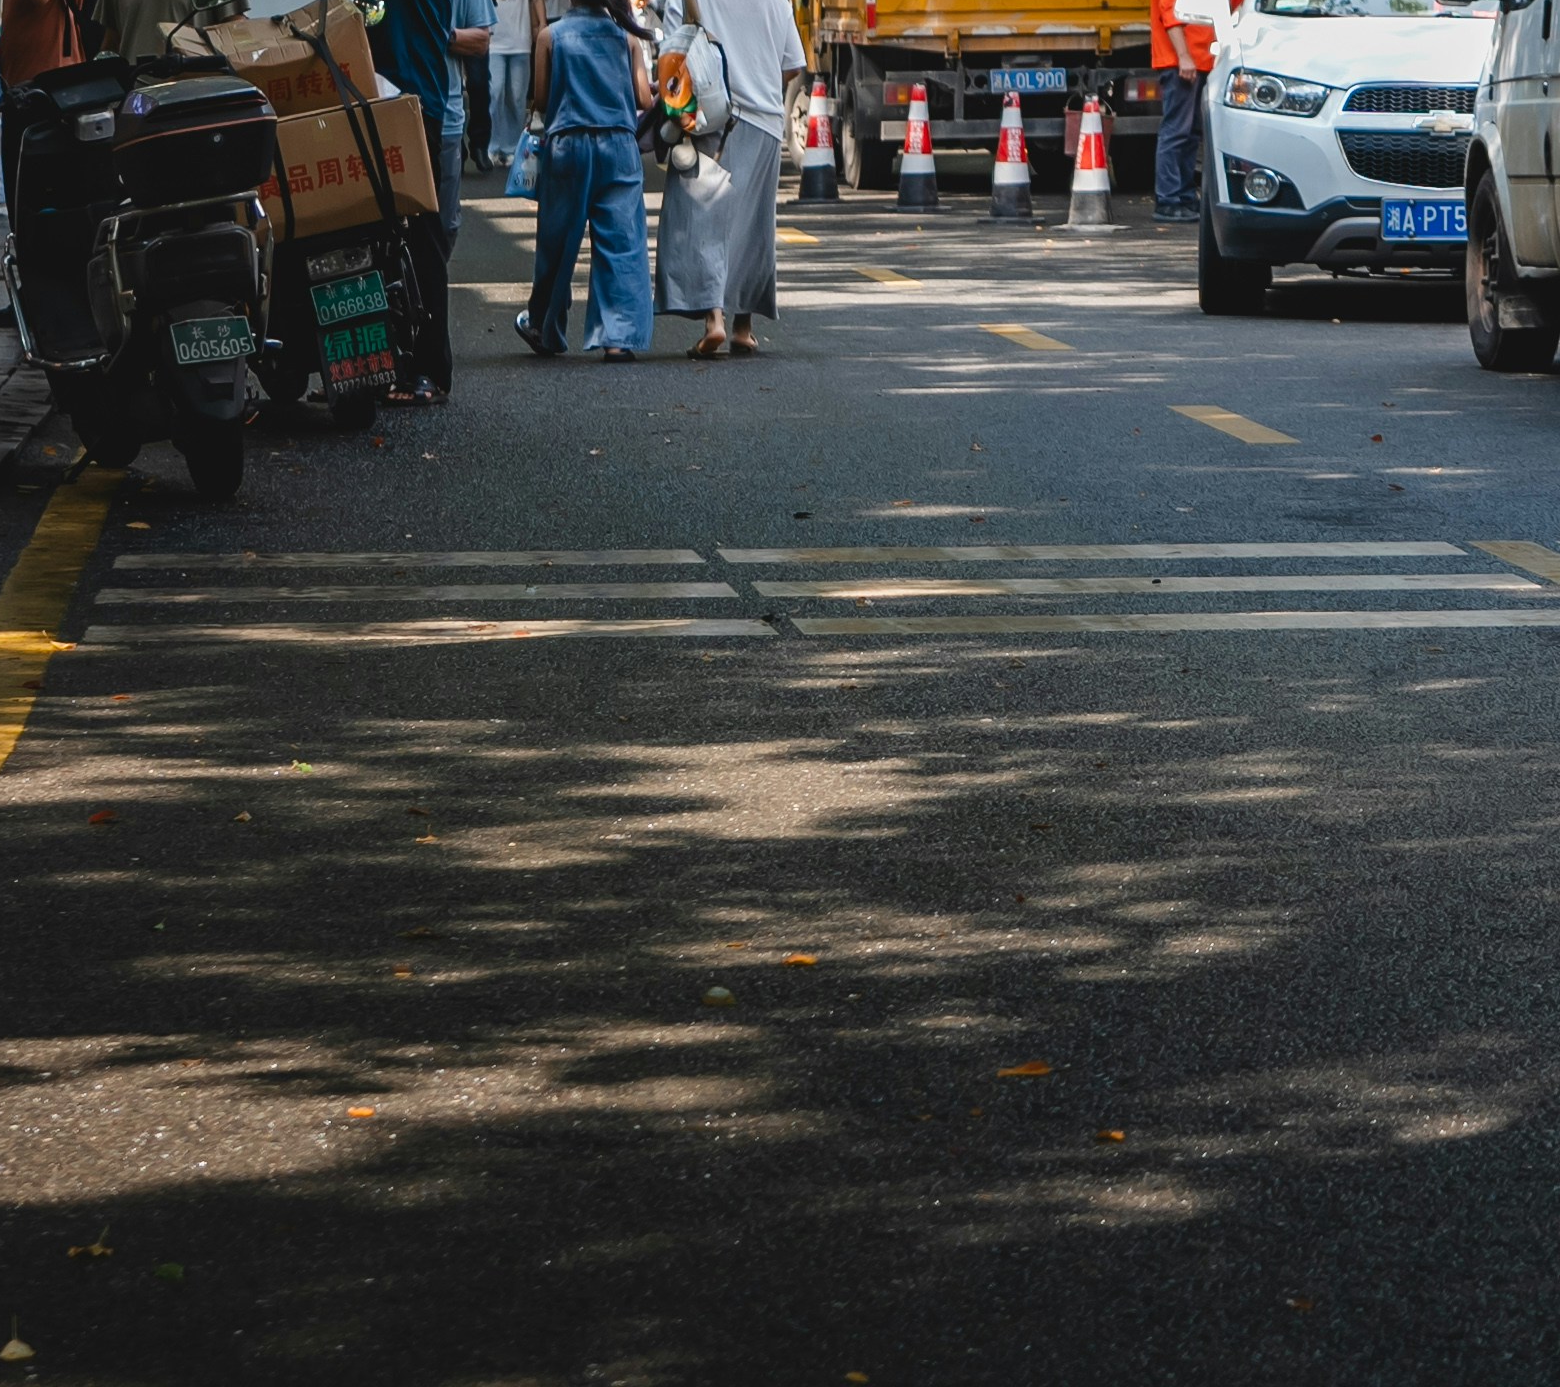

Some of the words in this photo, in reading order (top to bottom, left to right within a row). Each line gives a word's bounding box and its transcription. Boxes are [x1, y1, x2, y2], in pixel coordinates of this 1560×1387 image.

[320, 292, 385, 322] 0166838
[179, 337, 252, 360] 0605605
[324, 323, 390, 362] 绿源
